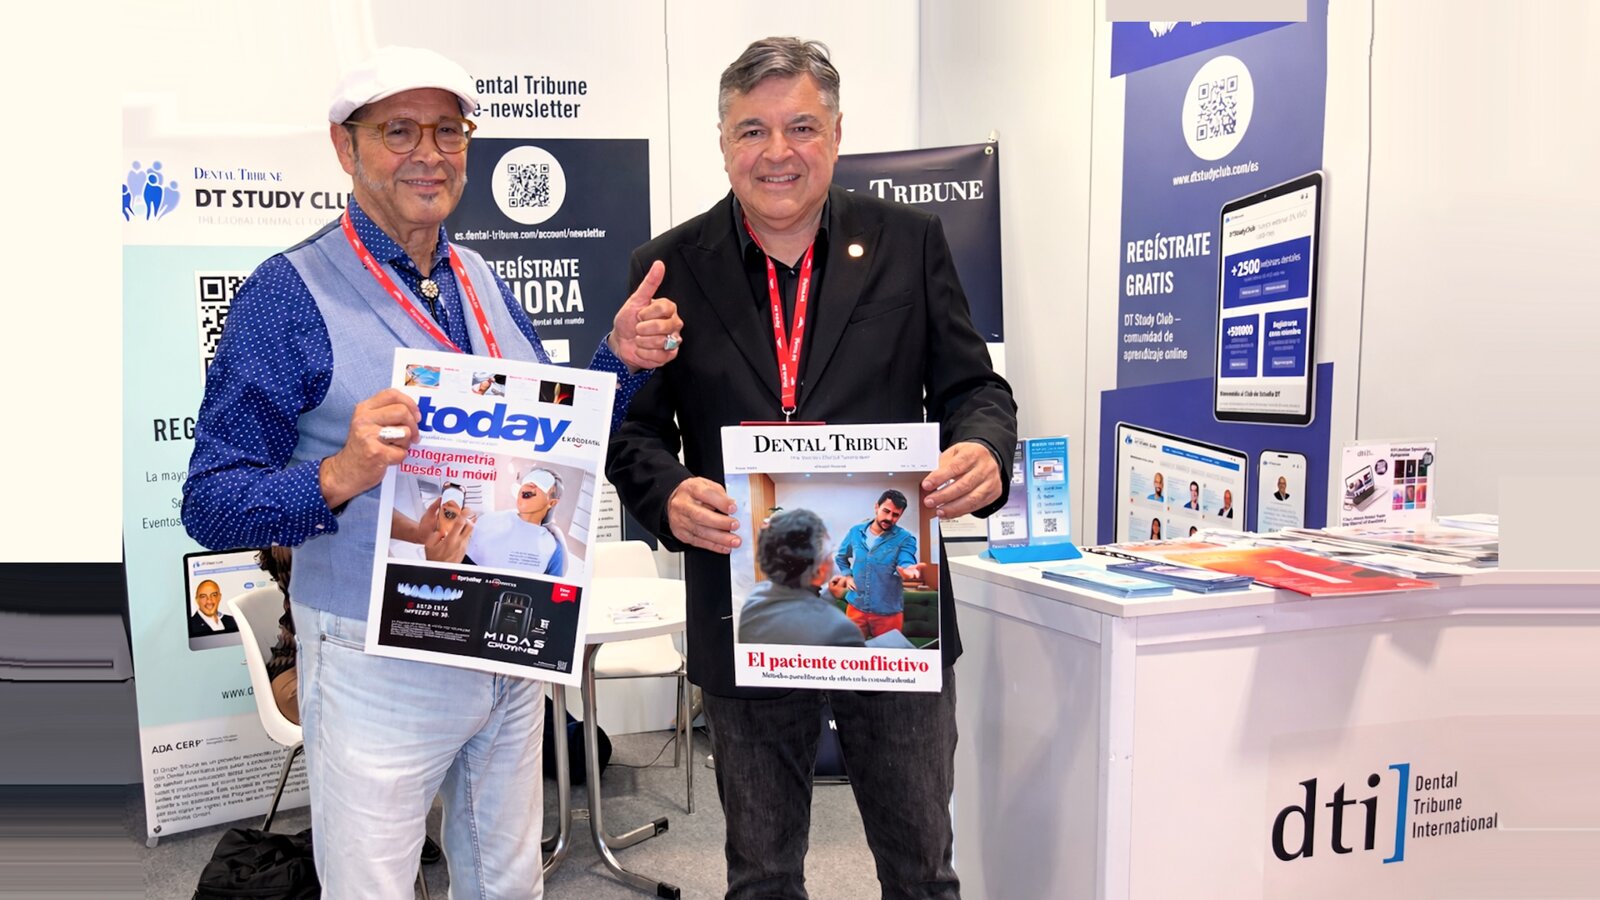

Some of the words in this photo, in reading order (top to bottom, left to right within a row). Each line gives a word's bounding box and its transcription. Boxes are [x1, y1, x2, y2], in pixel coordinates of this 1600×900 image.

[471, 75, 518, 95] ental
[524, 75, 588, 96] Tribune
[472, 99, 581, 118] e-newsletter
[1172, 161, 1259, 186] www.dtstudyclub.com/es
[195, 189, 227, 207] DT
[232, 190, 305, 208] STUDY
[310, 192, 352, 209] CLU
[869, 178, 984, 204] TRIBUNE
[454, 228, 606, 241] es.dental-tribune.com/account/newsletter
[1126, 231, 1211, 264] REGÍSTRATE
[1230, 258, 1261, 278] +2500
[1126, 271, 1175, 297] GRATIS
[505, 279, 585, 314] ORA
[554, 317, 563, 326] del
[565, 317, 585, 326] mundo
[1124, 315, 1134, 326] DT
[1135, 313, 1155, 327] Study
[1157, 311, 1174, 325] Club
[1124, 330, 1163, 343] comunidad
[1164, 330, 1174, 343] de
[1123, 348, 1164, 363] aprendizaje
[1165, 348, 1188, 360] online
[153, 416, 196, 441] REG
[416, 396, 572, 452] today
[753, 435, 826, 453] DENTAL
[829, 434, 908, 452] TRIBUNE
[146, 471, 158, 482] La
[161, 471, 188, 482] mayo
[463, 467, 497, 482] móvil
[142, 517, 182, 529] Eventos
[484, 631, 545, 649] MIDAS
[747, 652, 765, 668] El
[769, 653, 837, 672] paciente
[842, 655, 929, 673] conflictivo
[221, 686, 255, 699] www.d
[151, 743, 174, 754] ADA
[1415, 771, 1459, 792] Dental
[1413, 797, 1463, 815] Tribune
[1412, 812, 1499, 838] International
